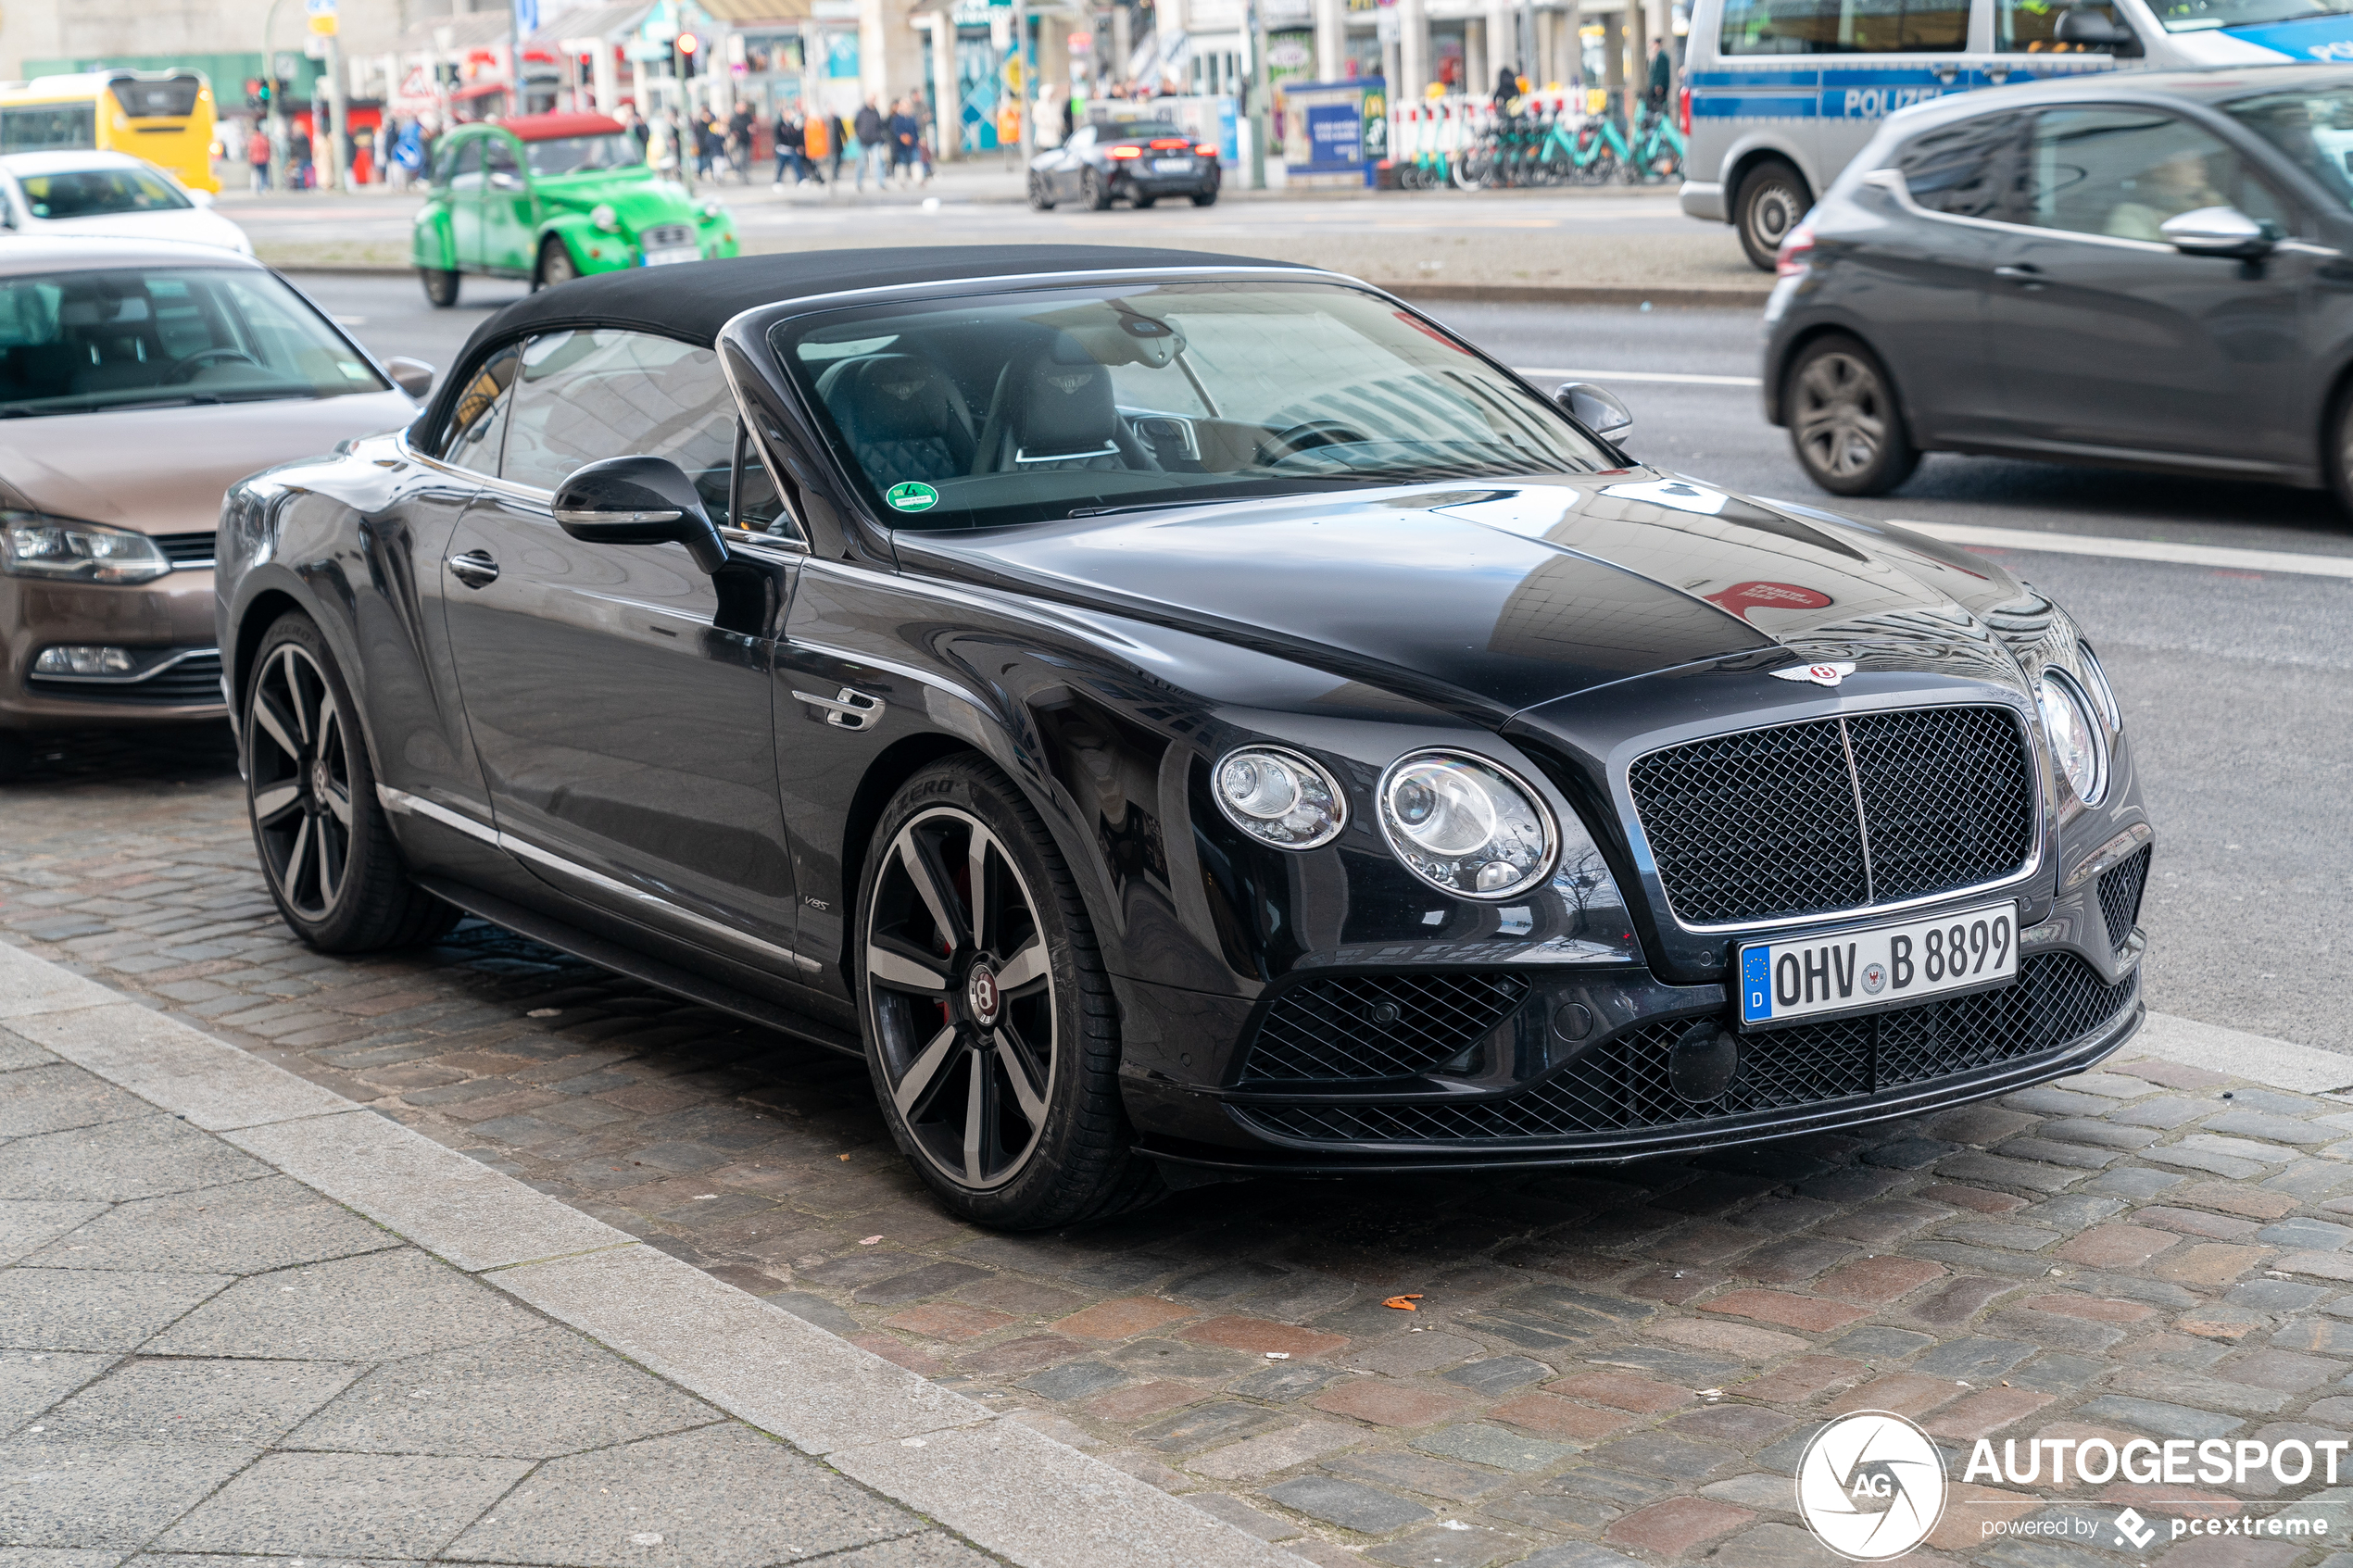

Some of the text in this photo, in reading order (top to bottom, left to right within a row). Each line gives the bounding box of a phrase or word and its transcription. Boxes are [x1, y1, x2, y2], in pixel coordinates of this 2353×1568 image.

[1843, 88, 1944, 117] POLIZ
[904, 484, 918, 496] 4
[896, 779, 955, 816] ZERO
[1776, 915, 2010, 1007] OHV B 8899
[1752, 992, 1764, 1008] D
